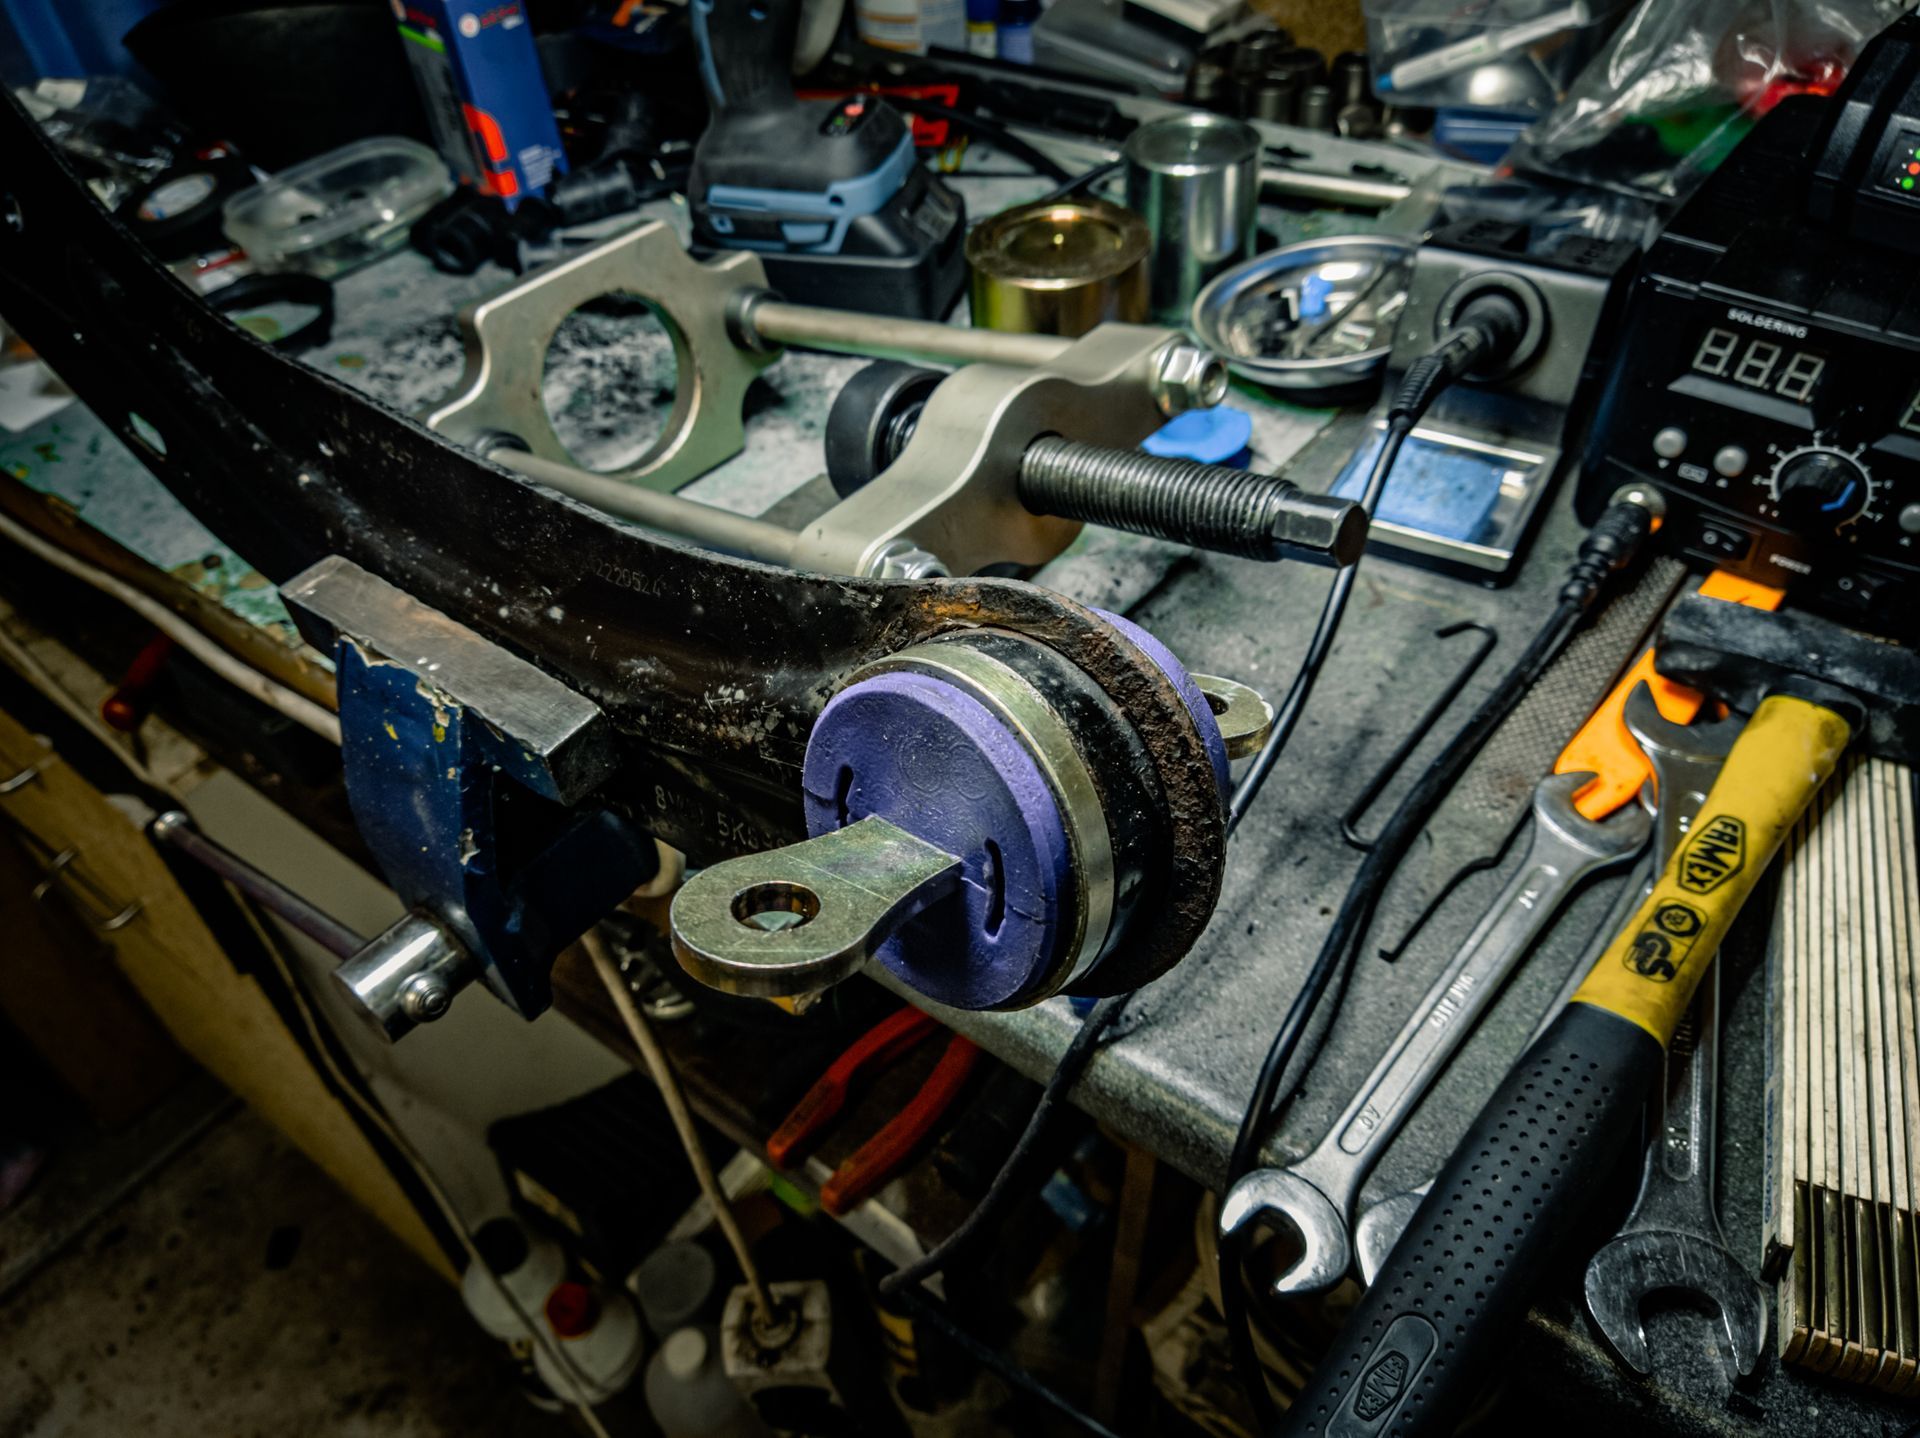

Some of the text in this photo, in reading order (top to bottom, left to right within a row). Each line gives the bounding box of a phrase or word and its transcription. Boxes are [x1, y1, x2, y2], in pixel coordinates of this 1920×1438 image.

[1726, 307, 1809, 339] SOLDERING
[1768, 553, 1813, 576] POWER
[1684, 820, 1739, 889] FAMEX
[1359, 1356, 1404, 1416] FAMEX
